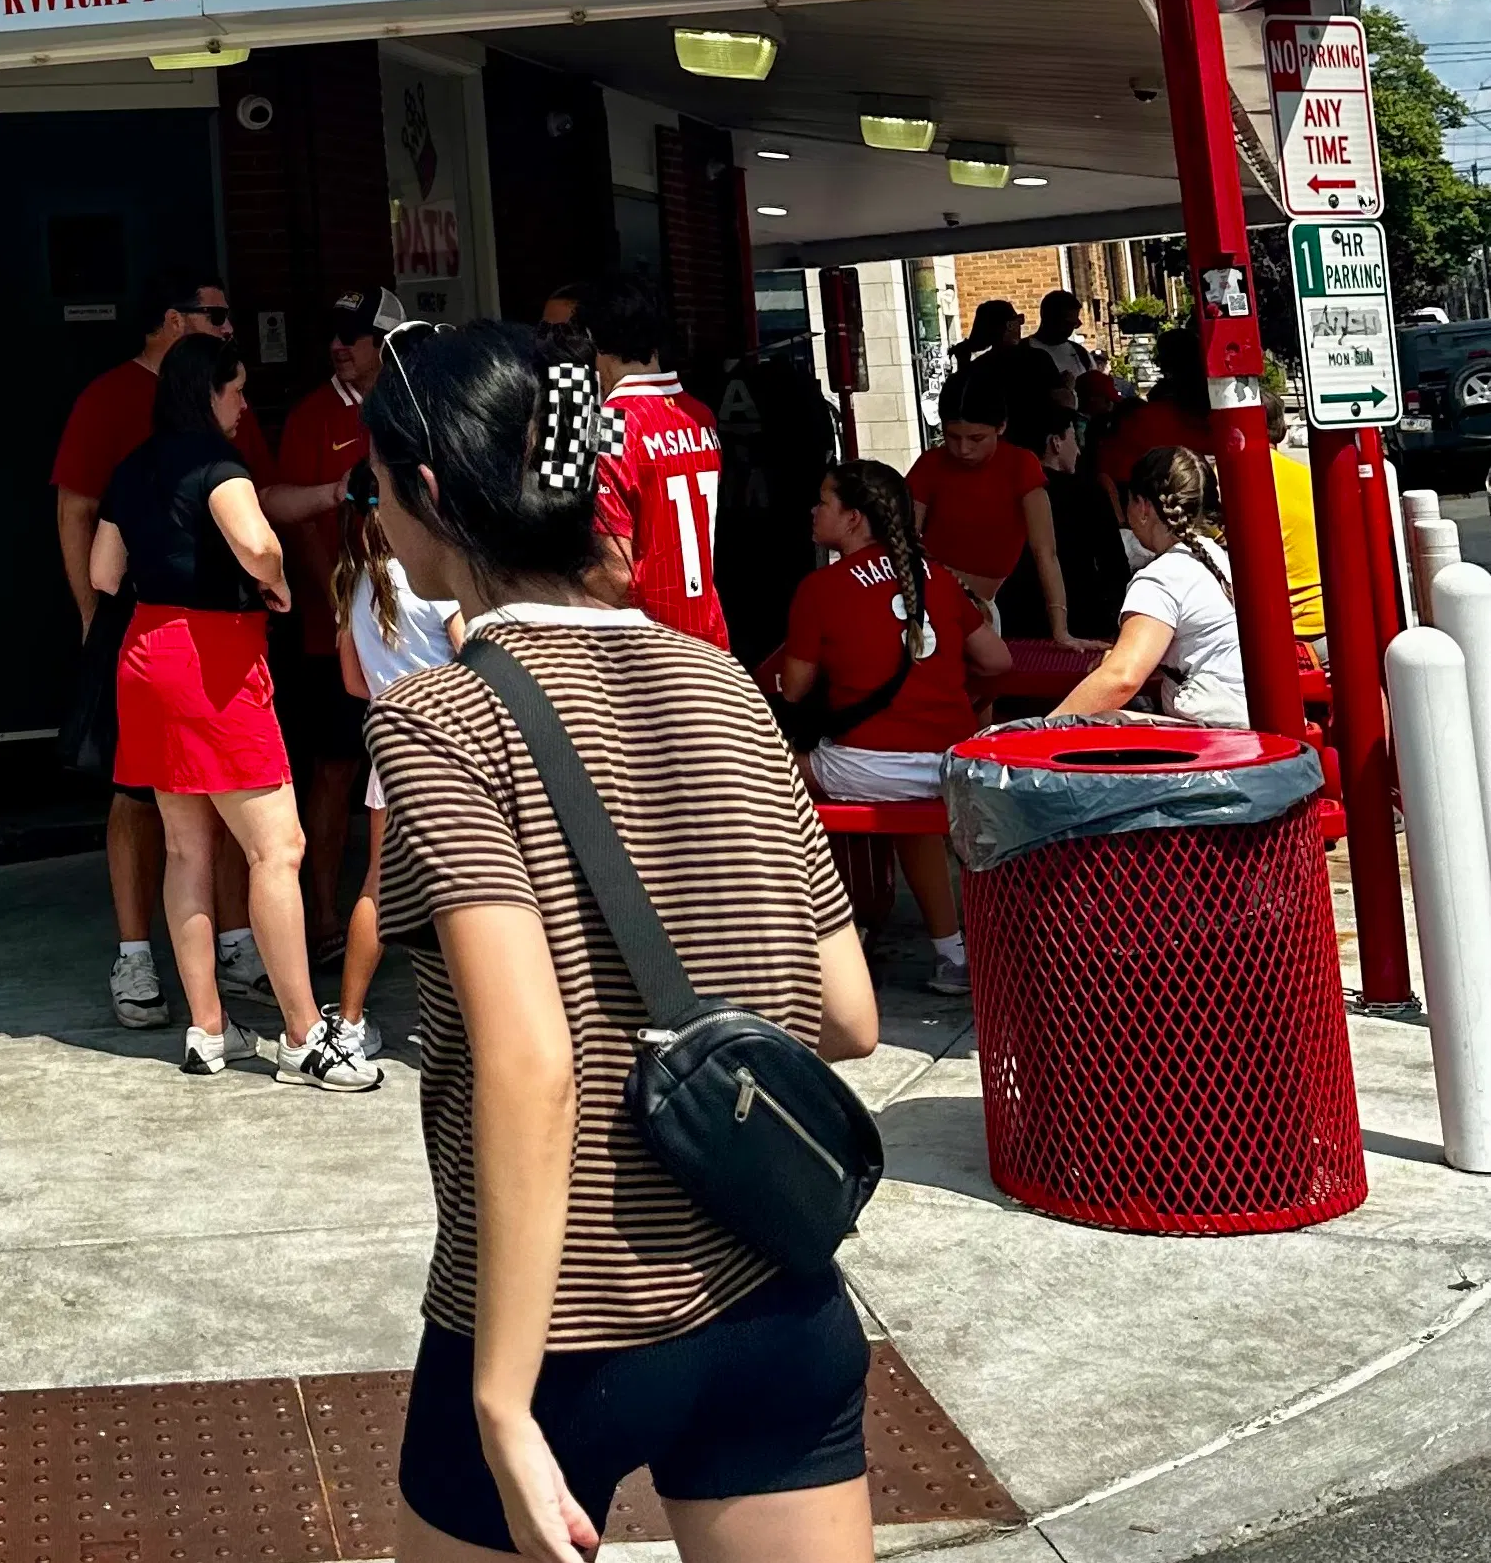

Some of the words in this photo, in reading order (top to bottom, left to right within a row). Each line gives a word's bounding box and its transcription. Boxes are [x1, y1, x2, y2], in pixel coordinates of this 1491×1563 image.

[1270, 39, 1297, 75] NO
[1300, 42, 1361, 69] PARKING
[1304, 98, 1343, 128] ANY
[1303, 136, 1352, 166] TIME
[1341, 233, 1364, 258] HR
[1300, 241, 1314, 290] 1
[1325, 261, 1383, 290] PARKING
[666, 470, 719, 598] 11
